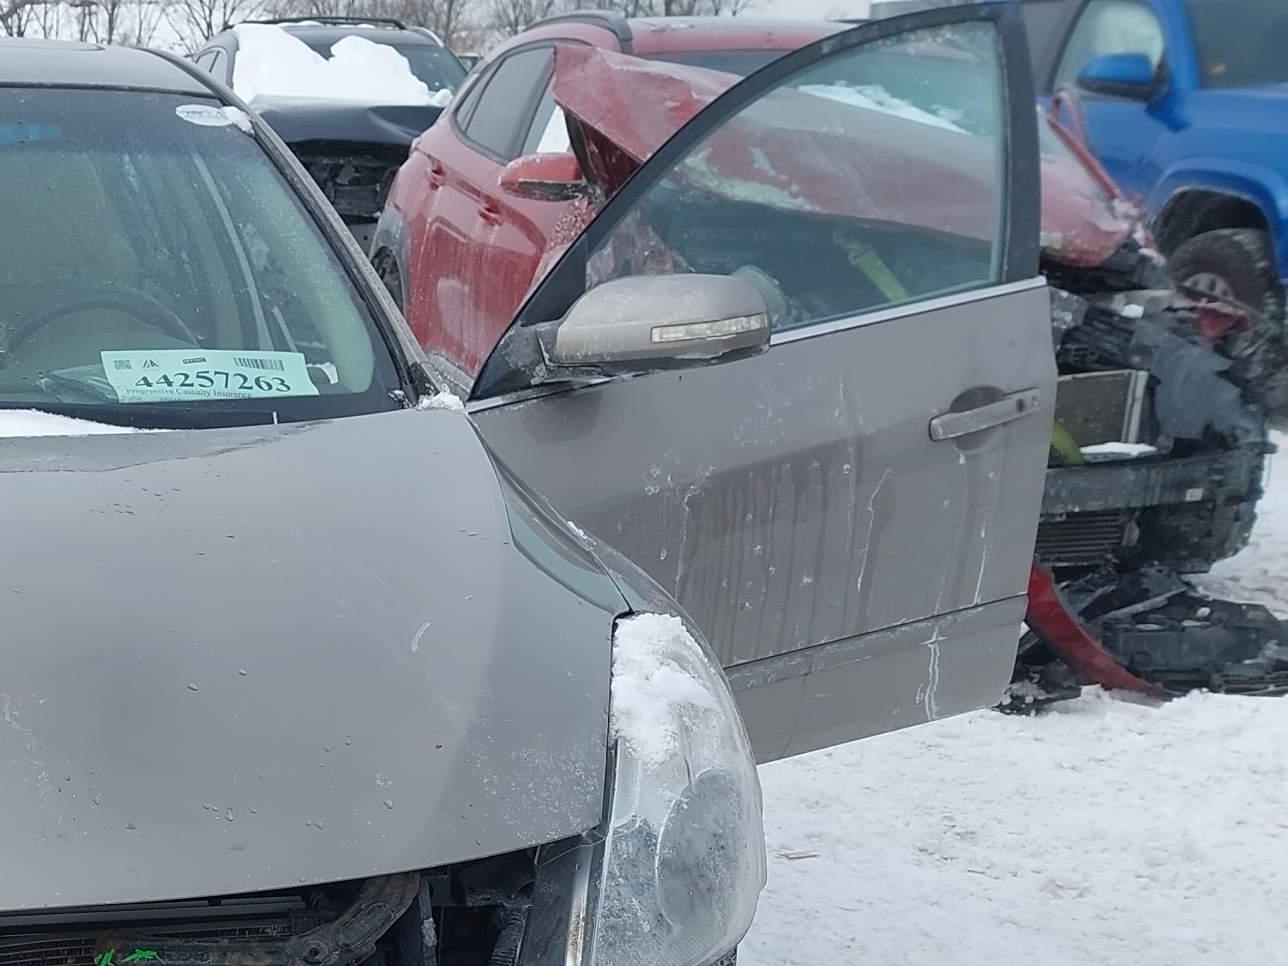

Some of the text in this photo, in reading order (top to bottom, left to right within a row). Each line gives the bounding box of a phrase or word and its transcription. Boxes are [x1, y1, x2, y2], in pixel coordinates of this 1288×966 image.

[135, 370, 291, 392] 44257263
[175, 388, 211, 398] Casualty
[213, 389, 253, 399] Insurance
